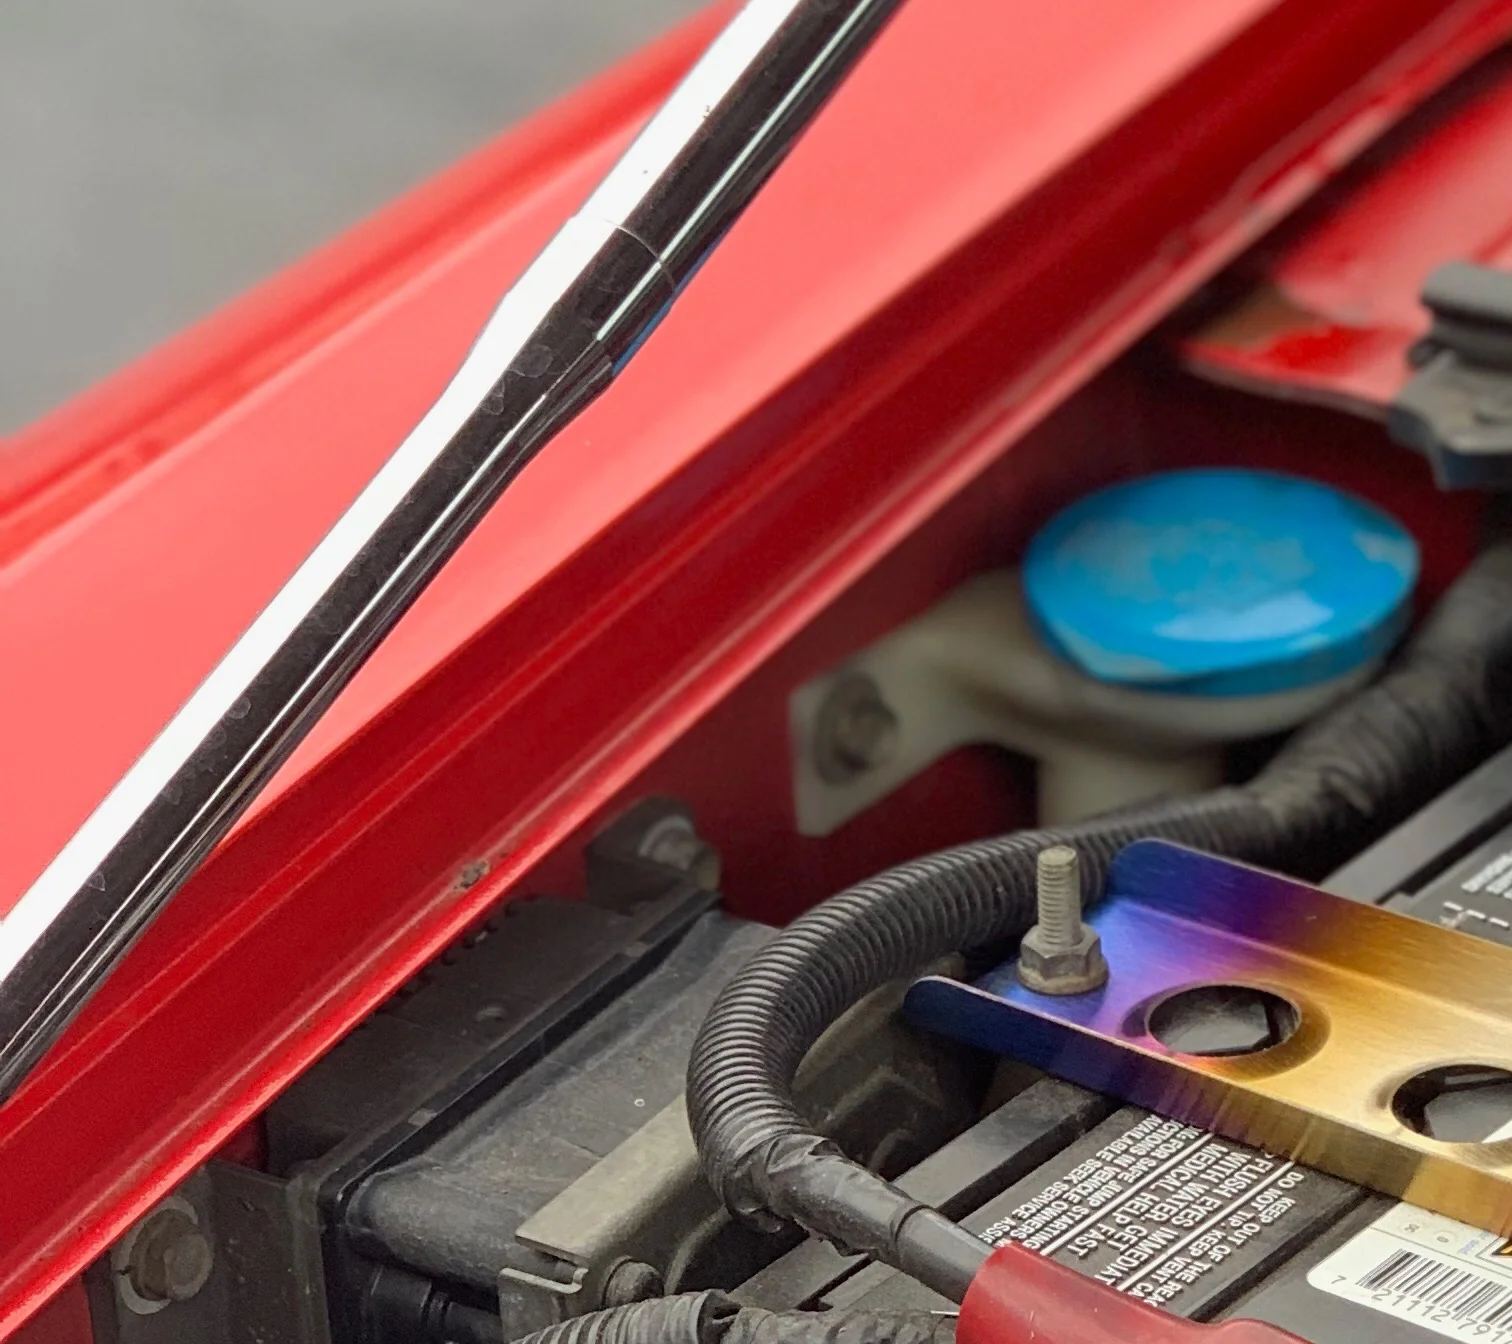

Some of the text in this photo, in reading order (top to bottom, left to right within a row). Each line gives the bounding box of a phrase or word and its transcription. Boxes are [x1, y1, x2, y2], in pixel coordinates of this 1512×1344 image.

[1095, 1115, 1163, 1162] AVAILABLE
[1150, 1138, 1184, 1159] FOR
[1063, 1158, 1103, 1184] SEEK
[1113, 1154, 1136, 1168] IN
[1117, 1157, 1157, 1183] SAFE
[1062, 1166, 1121, 1203] VEHICLE
[1212, 1158, 1273, 1198] FLUSH
[1277, 1171, 1305, 1188] DO
[1011, 1181, 1070, 1219] SERVICE
[1067, 1143, 1228, 1256] MEDICAL HELP FAST
[1086, 1180, 1123, 1207] JUMP
[1107, 1152, 1251, 1252] WITH WATER. GET
[1250, 1187, 1283, 1211] NOT
[1009, 1200, 1069, 1239] OWNERS
[1171, 1195, 1223, 1227] EYES
[1258, 1197, 1296, 1223] KEEP
[1022, 1205, 1090, 1250] STARTING
[1227, 1222, 1261, 1245] OUT
[1188, 1229, 1226, 1257] KEEP
[1207, 1244, 1232, 1262] OF
[1151, 1256, 1192, 1283] VENT
[1175, 1261, 1212, 1283] THE
[1331, 1274, 1347, 1285] 7
[1371, 1288, 1451, 1323] 21112
